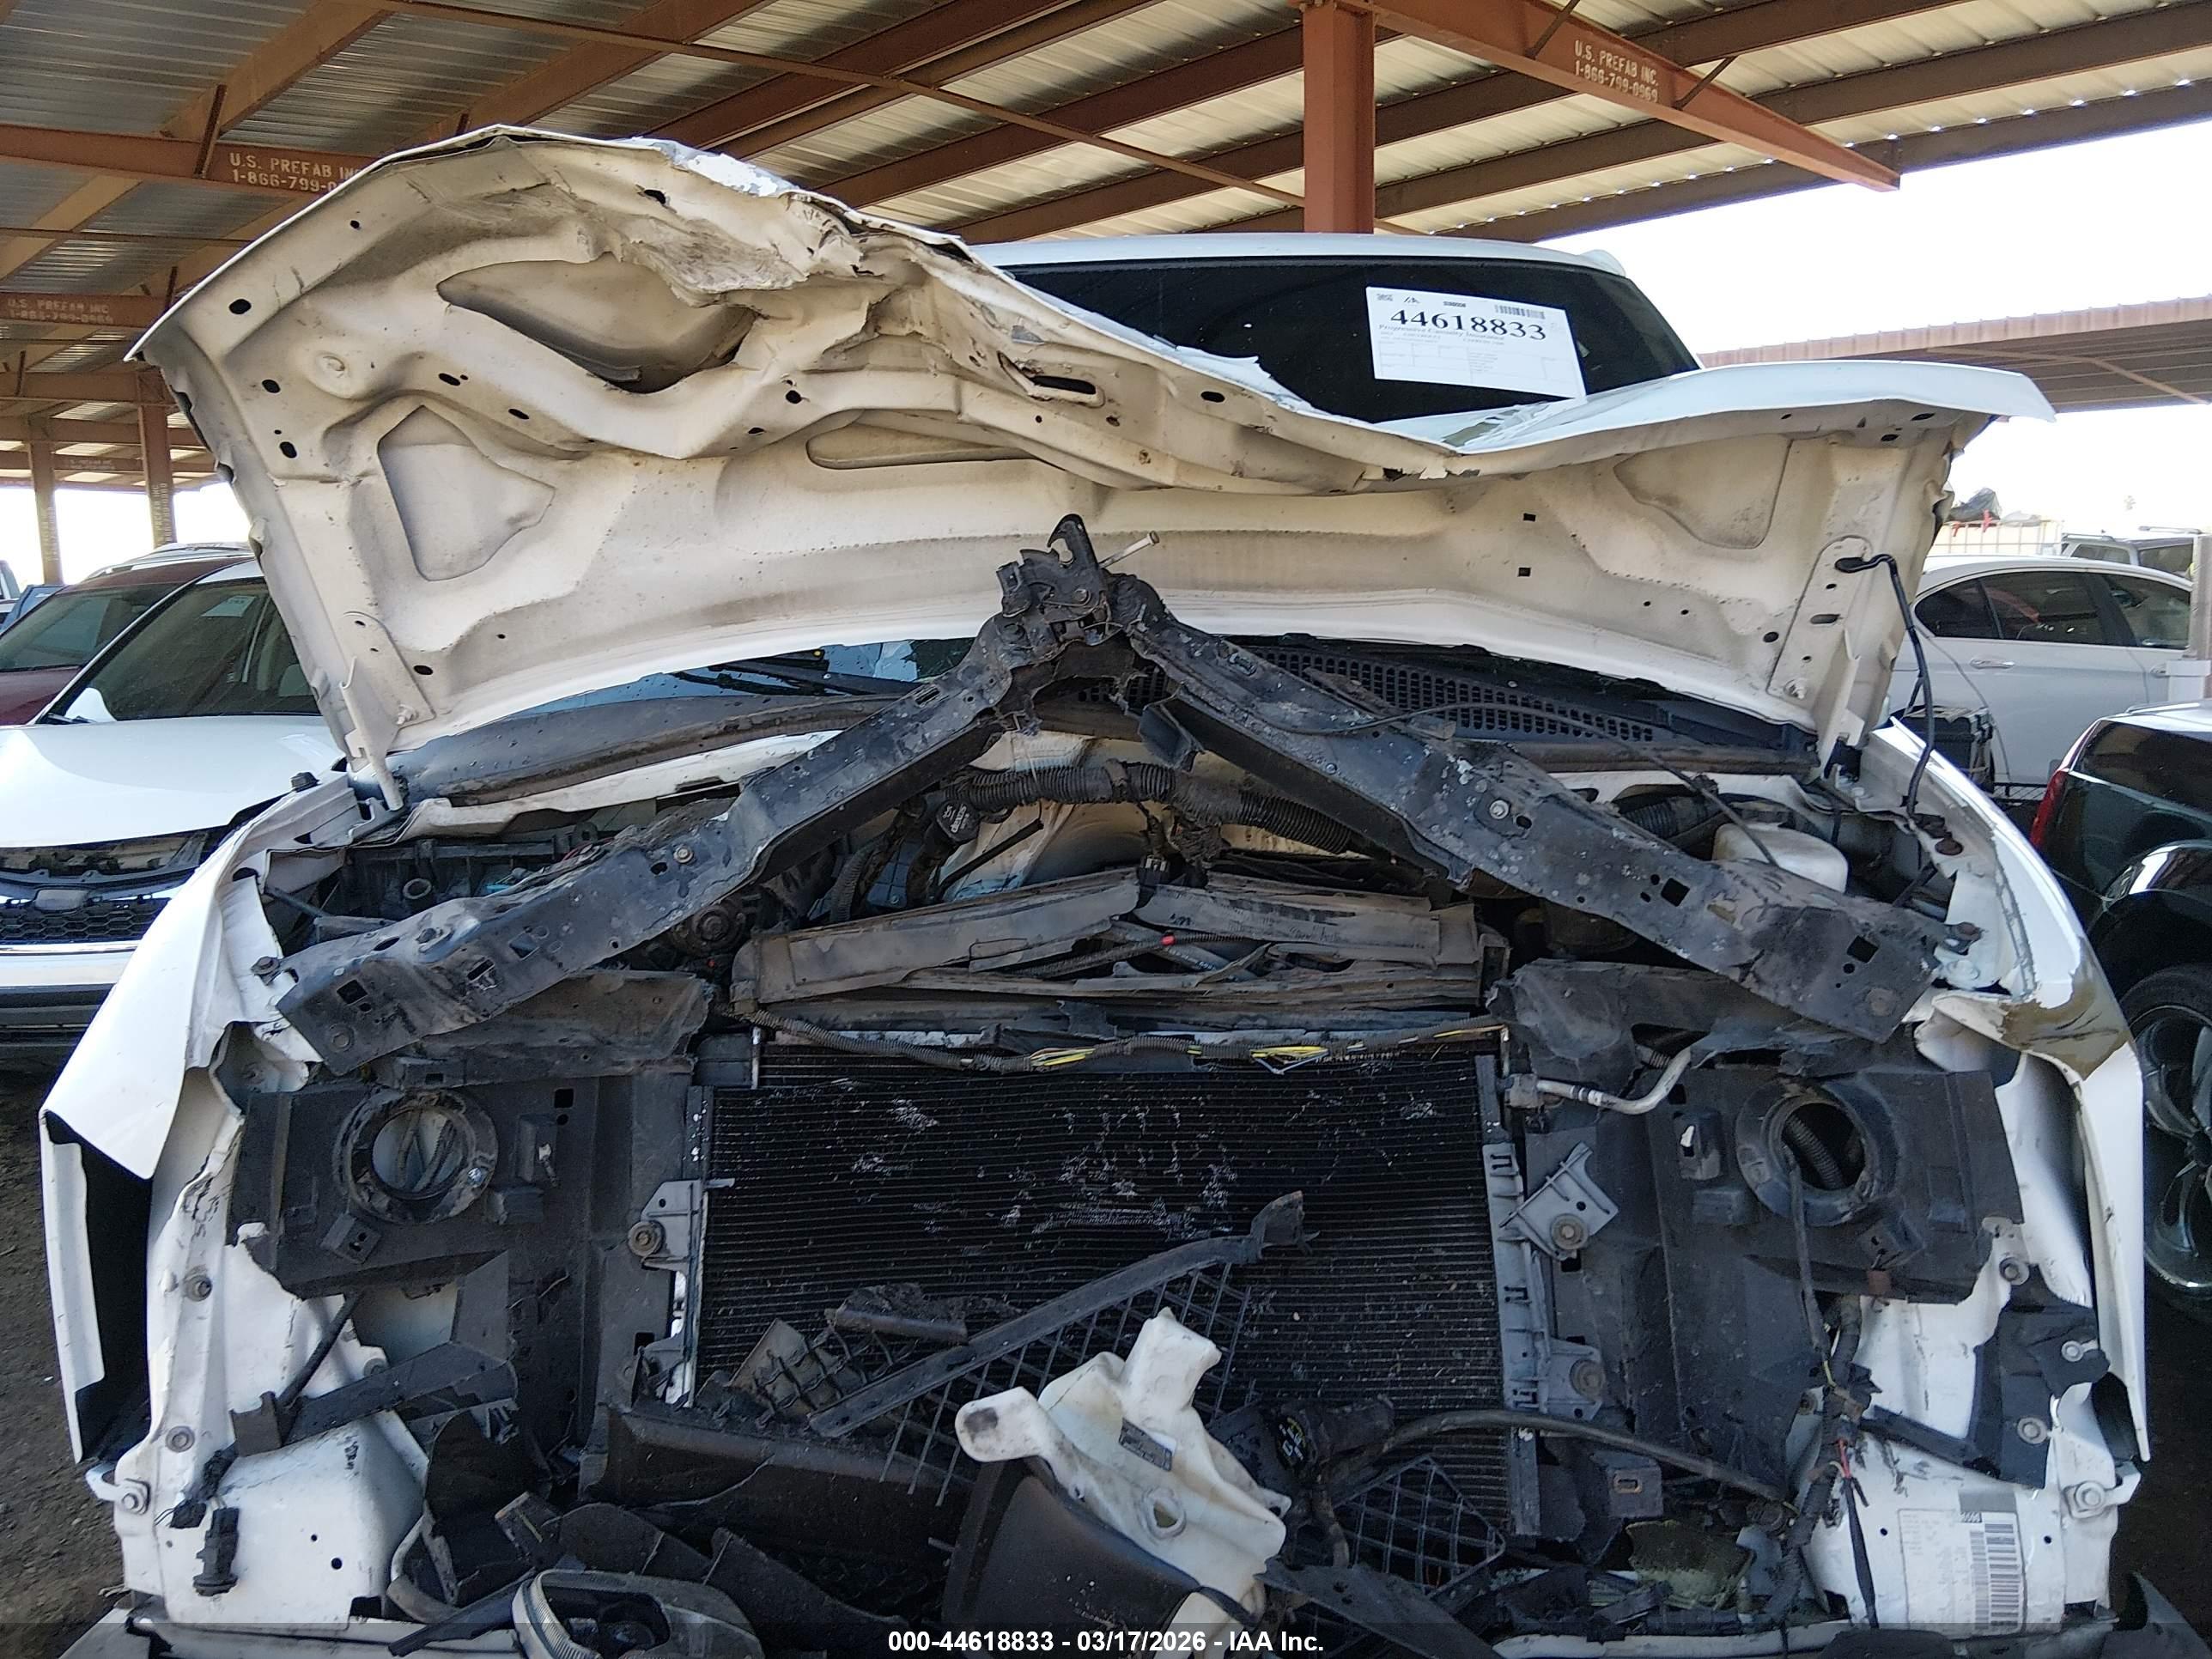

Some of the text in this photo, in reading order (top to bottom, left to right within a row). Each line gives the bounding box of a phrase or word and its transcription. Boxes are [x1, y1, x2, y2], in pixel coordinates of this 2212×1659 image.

[1575, 40, 1659, 86] U.S. PREFAB INC.
[229, 152, 262, 170] U.S.
[270, 158, 332, 178] PREFAB
[1390, 309, 1547, 341] 44618833
